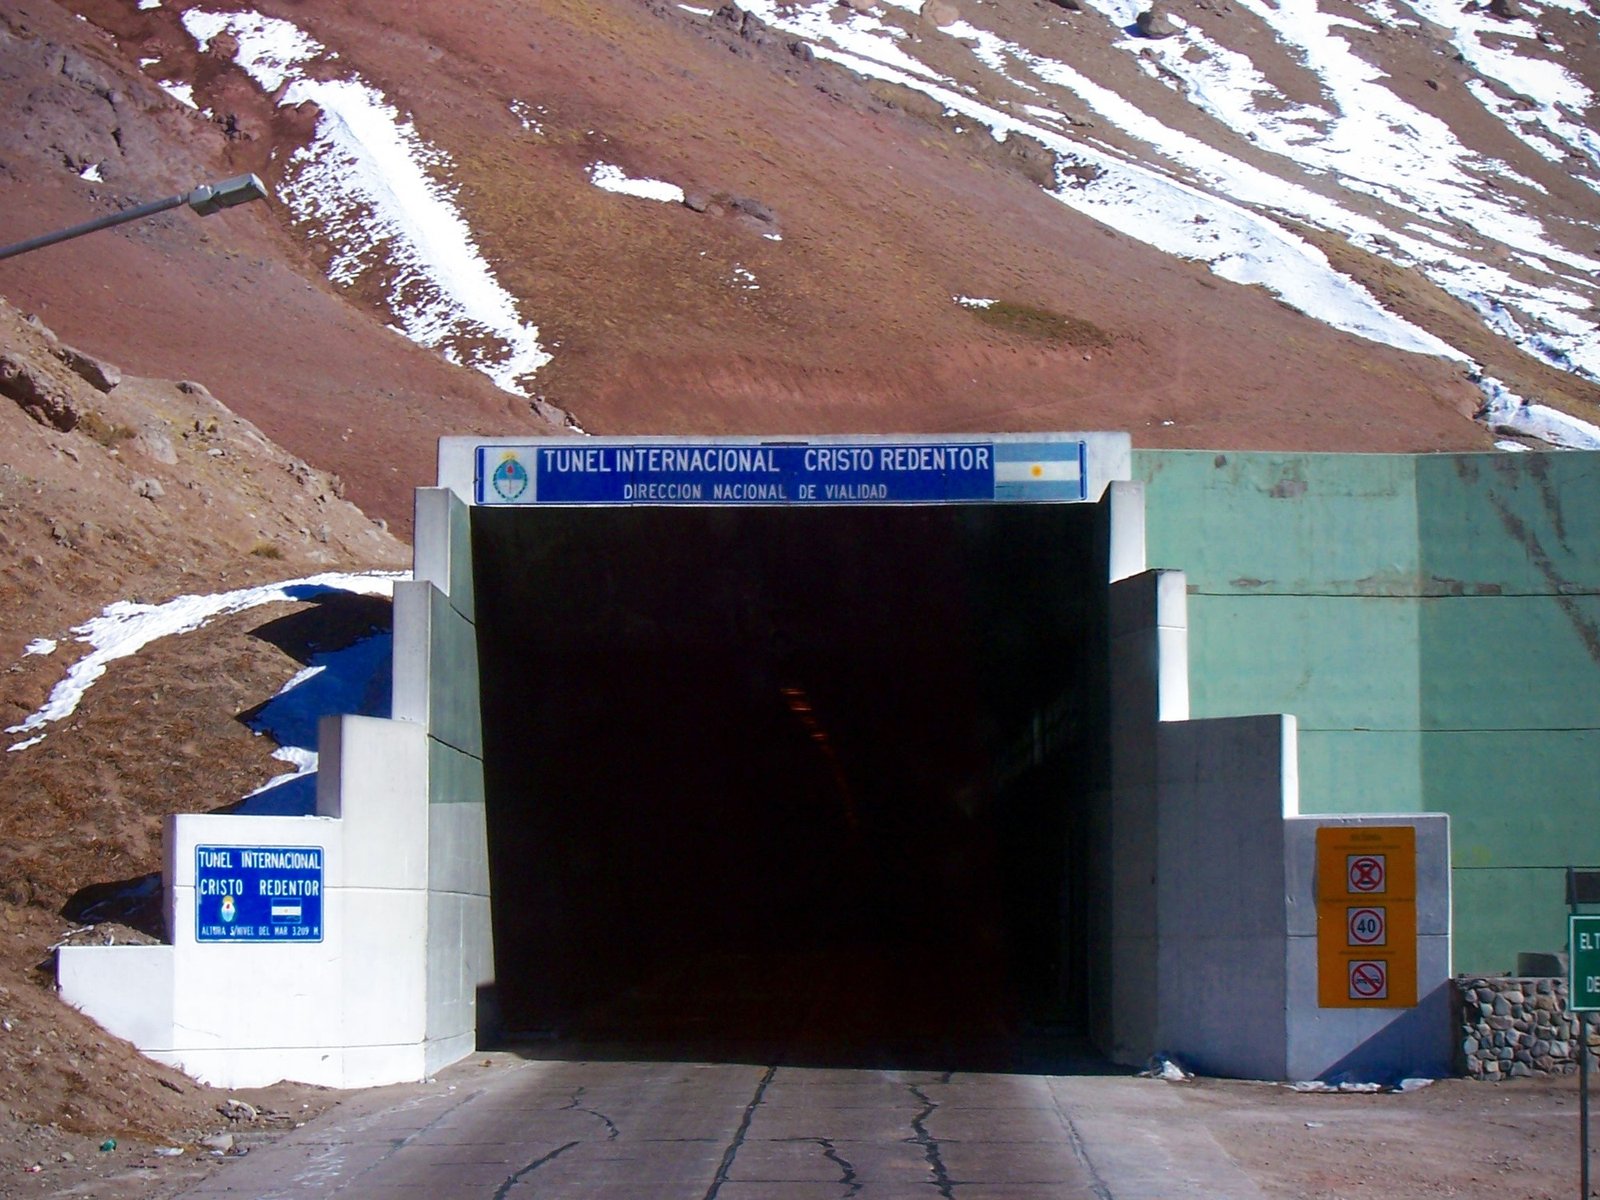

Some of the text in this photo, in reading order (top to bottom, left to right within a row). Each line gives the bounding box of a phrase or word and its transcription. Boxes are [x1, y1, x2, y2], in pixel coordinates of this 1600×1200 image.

[544, 447, 989, 473] TUNEL INTERNACIONAL CRISTO REDENTOR
[623, 484, 887, 500] DIRECCION NACIONAL DE VIALIDAD
[199, 851, 321, 869] TUNEL INTERNACIONAL
[200, 879, 319, 896] CRISTO REDENTOR
[258, 926, 270, 936] DEL
[274, 926, 288, 936] MAR
[1356, 918, 1376, 934] 40
